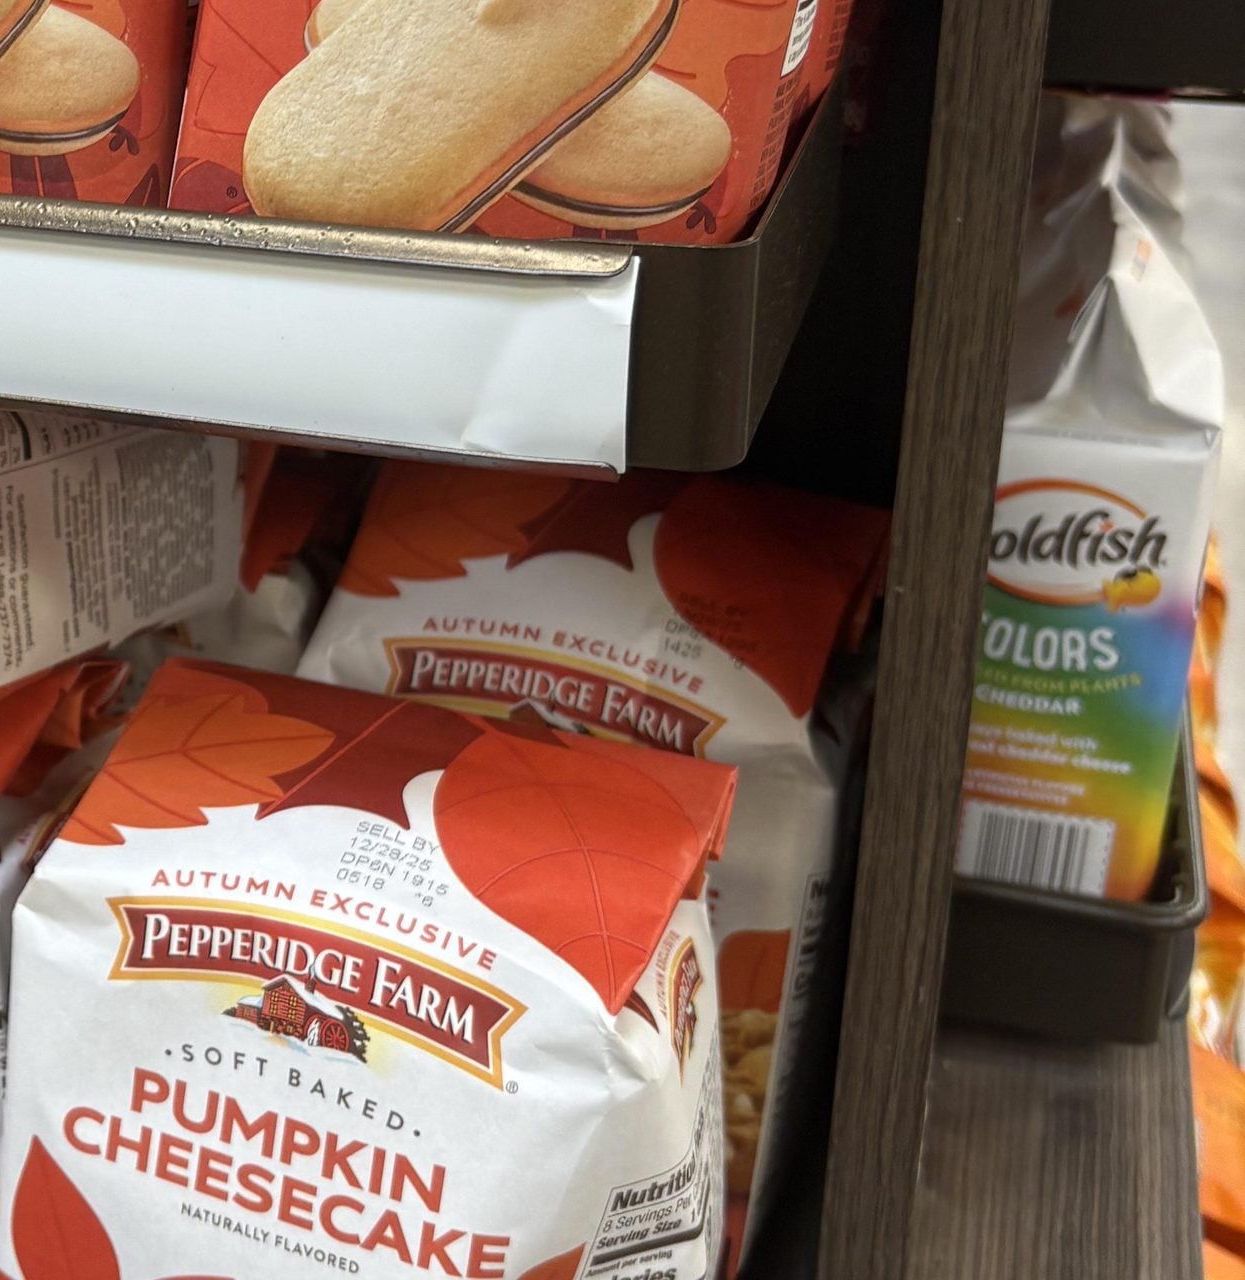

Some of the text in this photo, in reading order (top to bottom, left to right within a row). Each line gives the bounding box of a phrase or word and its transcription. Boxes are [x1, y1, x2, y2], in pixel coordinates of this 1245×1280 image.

[5, 484, 14, 506] For
[4, 510, 17, 573] questions
[17, 493, 30, 570] Satisfaction
[990, 507, 1167, 569] oldfish
[422, 616, 707, 696] AUTUMN EXCLUSIVE
[983, 613, 1120, 672] OLORS
[409, 649, 685, 752] PEPPERIDGE FARM
[974, 682, 1083, 717] CHEDDAR
[349, 836, 433, 872] 12/28/25
[356, 820, 440, 855] SELL BY
[336, 867, 386, 891] 0518
[402, 870, 450, 896] 1915
[150, 867, 499, 972] AUTUMN EXCLUSIVE
[140, 913, 477, 1046] PEPPERIDGE FARM
[180, 1041, 406, 1134] SOFT BAKED
[129, 1066, 448, 1216] PUMPKIN
[60, 1103, 513, 1280] CHEESECAKE
[602, 1219, 613, 1233] 8
[615, 1205, 673, 1231] Servings
[180, 1202, 360, 1275] NATURALLY FLAVORED
[596, 1218, 682, 1250] Serving Size
[639, 1249, 673, 1263] serving
